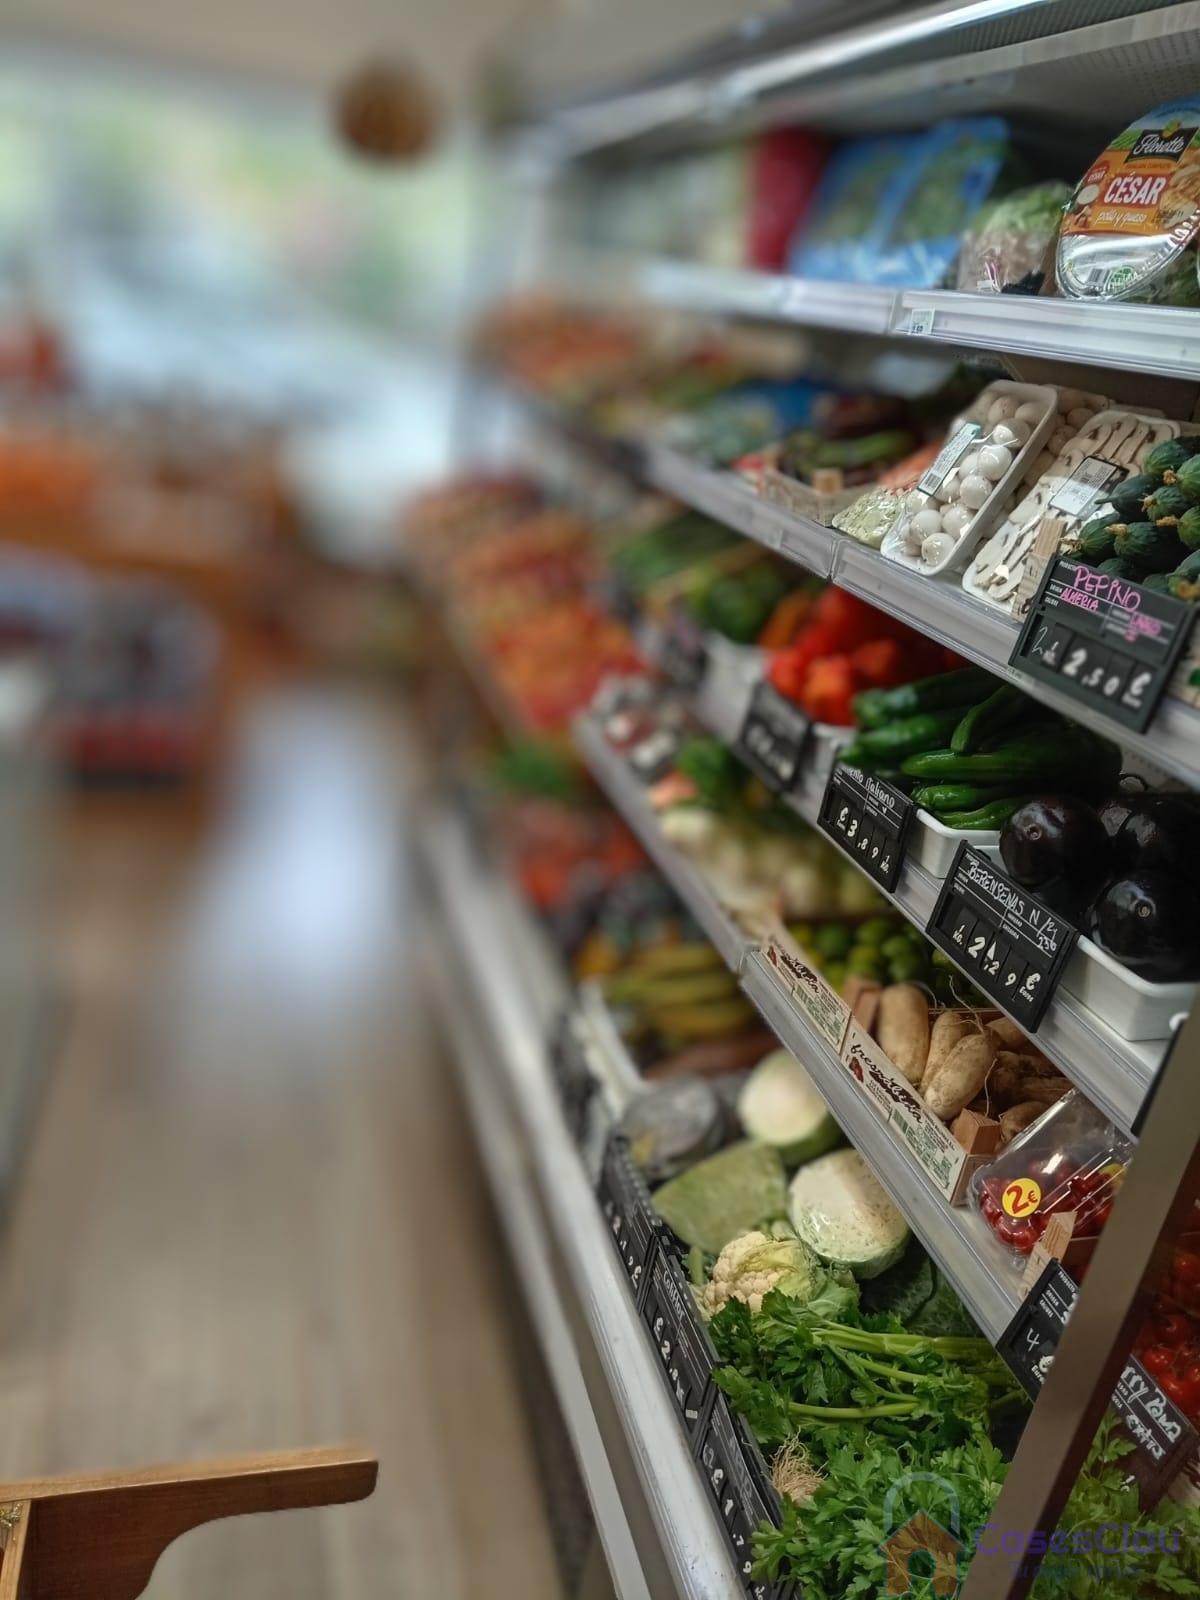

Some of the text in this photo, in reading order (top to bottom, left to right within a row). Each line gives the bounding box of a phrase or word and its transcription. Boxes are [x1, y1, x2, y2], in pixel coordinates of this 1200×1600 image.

[1104, 171, 1167, 205] CÉSAR
[1074, 566, 1141, 612] PEPINO
[1026, 1327, 1040, 1352] 4
